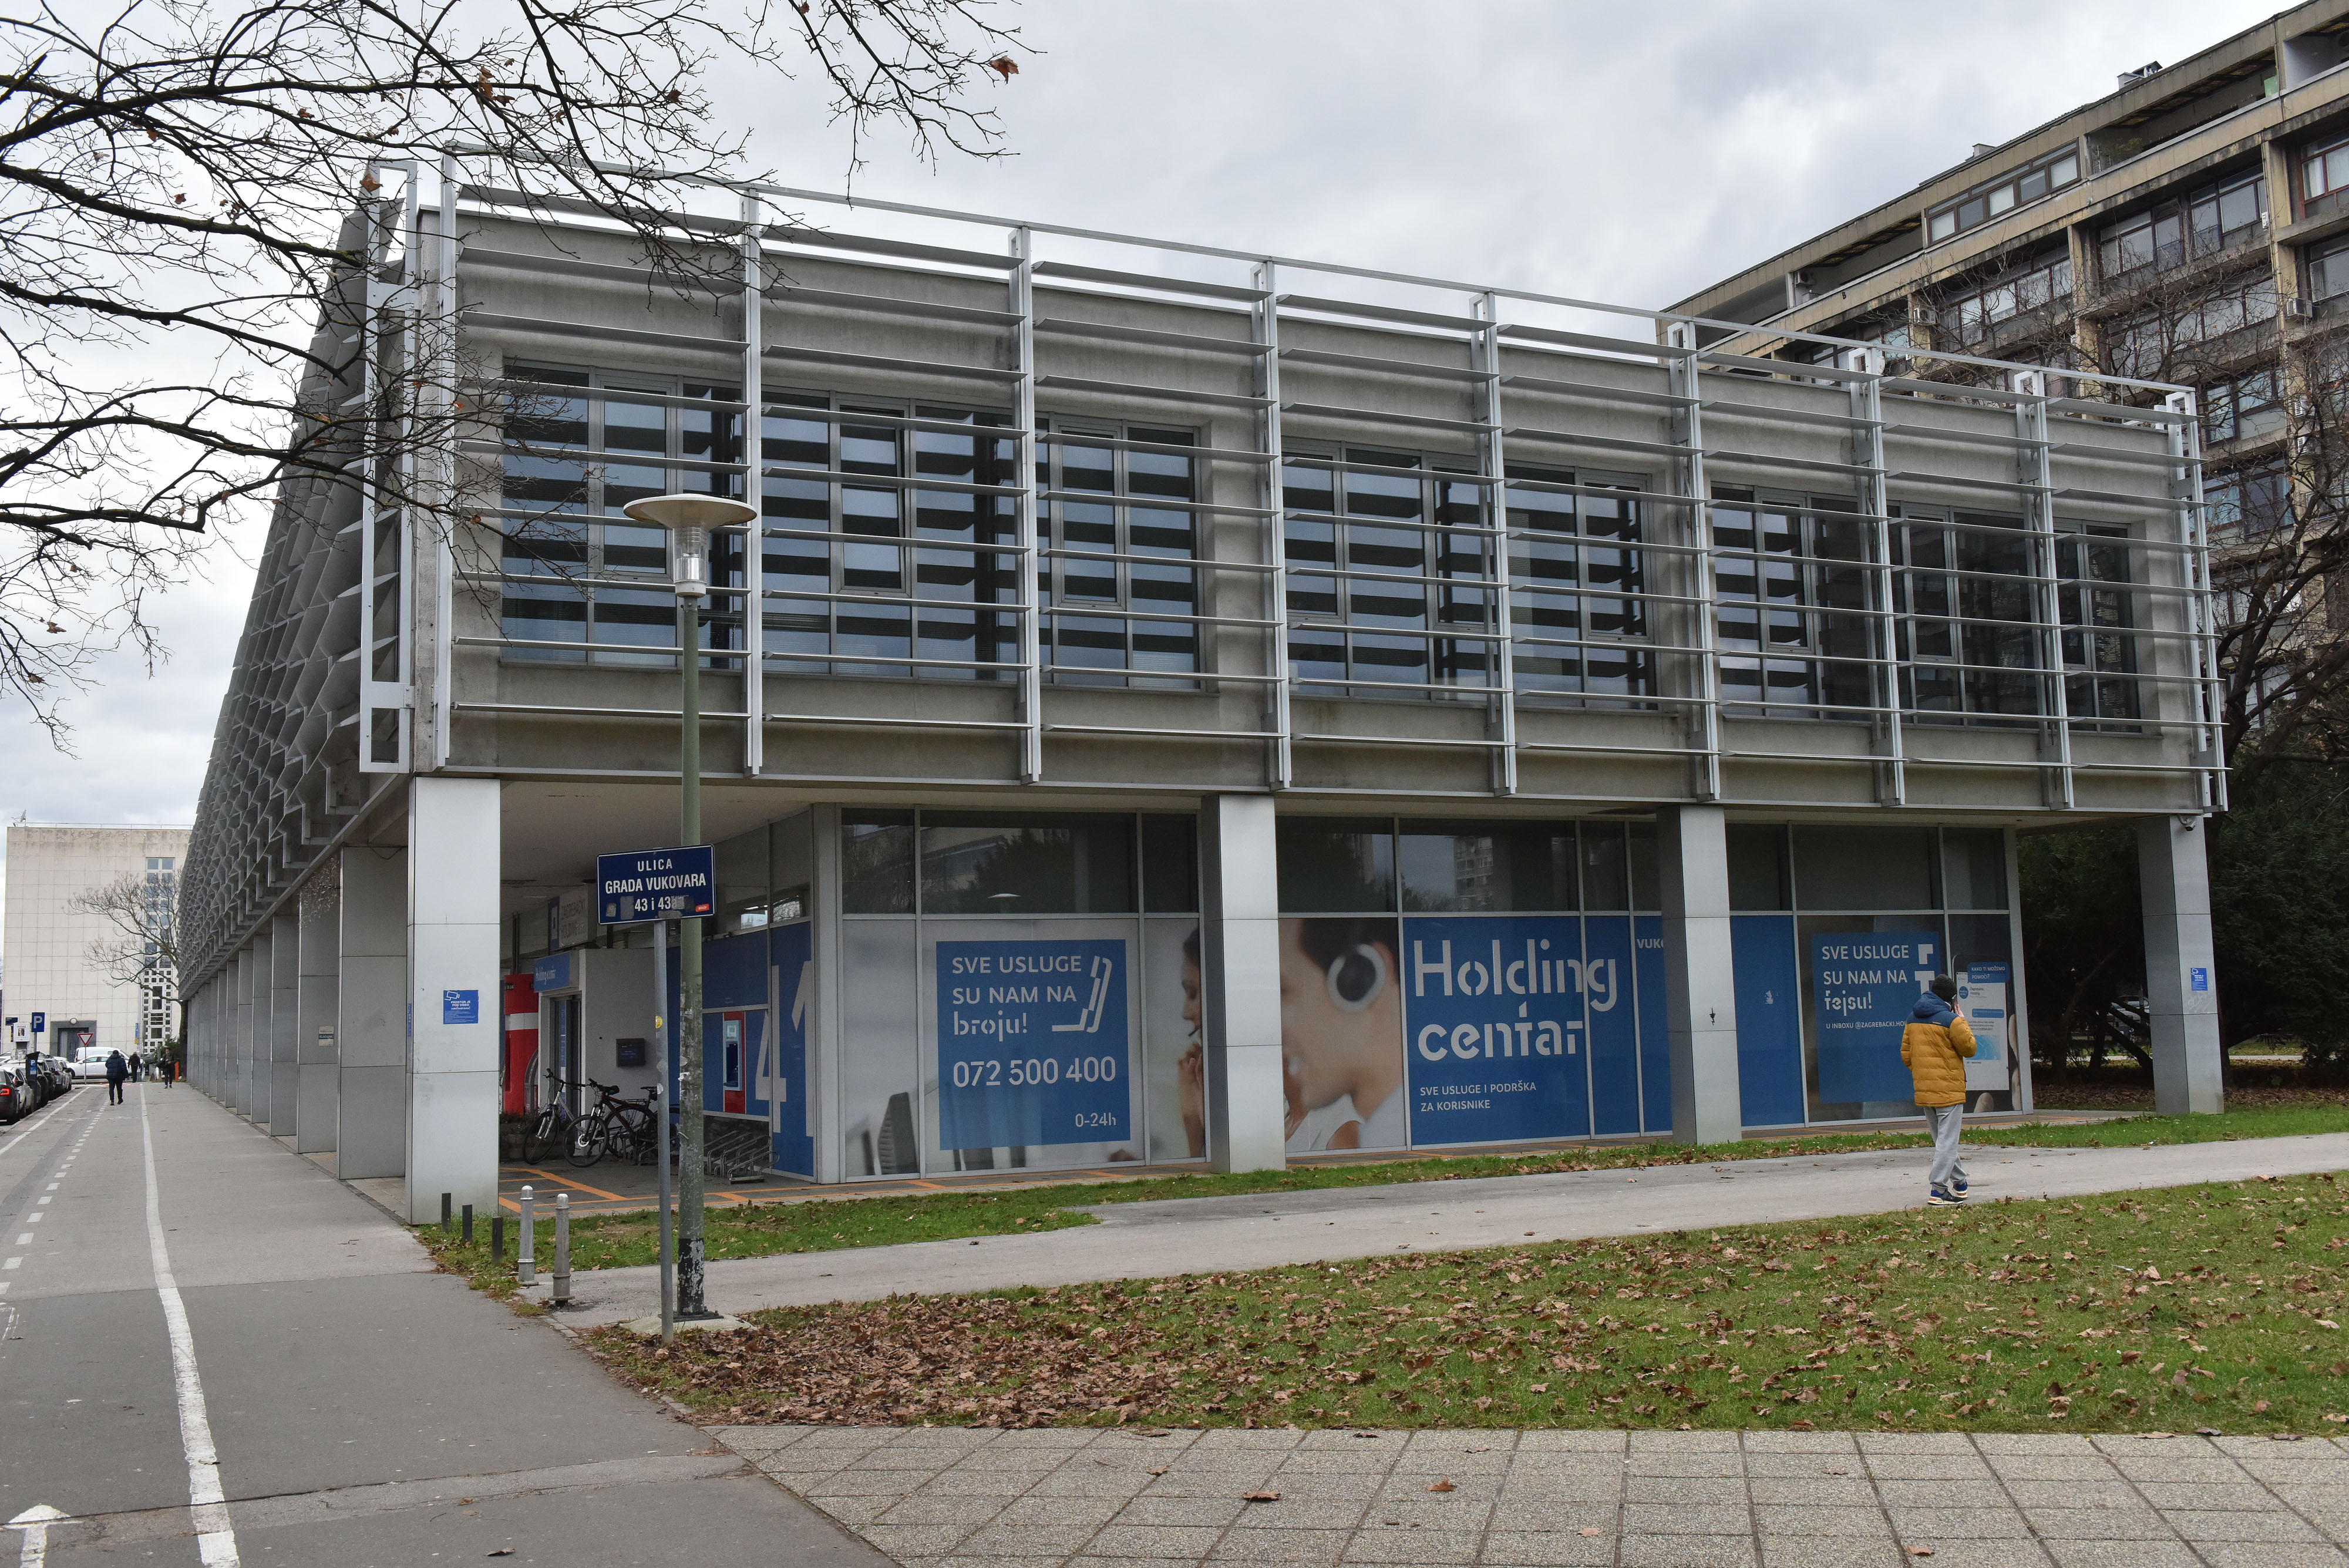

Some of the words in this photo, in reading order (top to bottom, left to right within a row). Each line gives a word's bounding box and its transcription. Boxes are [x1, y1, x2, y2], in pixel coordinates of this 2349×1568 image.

[637, 859, 673, 872] ULICA
[605, 879, 643, 894] GRADA
[646, 873, 706, 891] VUKOVARA
[635, 898, 648, 911] 43
[651, 897, 655, 910] i
[1822, 945, 1849, 960] SVE
[1853, 945, 1909, 959] USLUGE
[952, 957, 991, 974] SVE
[999, 955, 1082, 973] USLUGE
[1414, 938, 1617, 1012] Holding
[1823, 971, 1842, 985] SU
[1848, 970, 1882, 984] NAM
[1887, 969, 1908, 983] NA
[953, 987, 980, 1004] SU
[989, 986, 1038, 1003] NAM
[1047, 985, 1077, 1002] NA
[1825, 990, 1873, 1017] fejsu!
[33, 1015, 43, 1029] P
[954, 1010, 1027, 1042] broju!
[1418, 1001, 1584, 1061] centar
[953, 1059, 1001, 1088] 072
[1008, 1058, 1058, 1085] 500
[1065, 1056, 1116, 1082] 400
[1420, 1086, 1439, 1096] SVE
[1442, 1085, 1481, 1095] USLUGE
[1484, 1085, 1488, 1093] I
[1490, 1079, 1537, 1093] PODRŠKA
[1421, 1102, 1434, 1112] ZA
[1437, 1099, 1490, 1111] KORISNIKE
[1075, 1112, 1117, 1128] 0-24h
